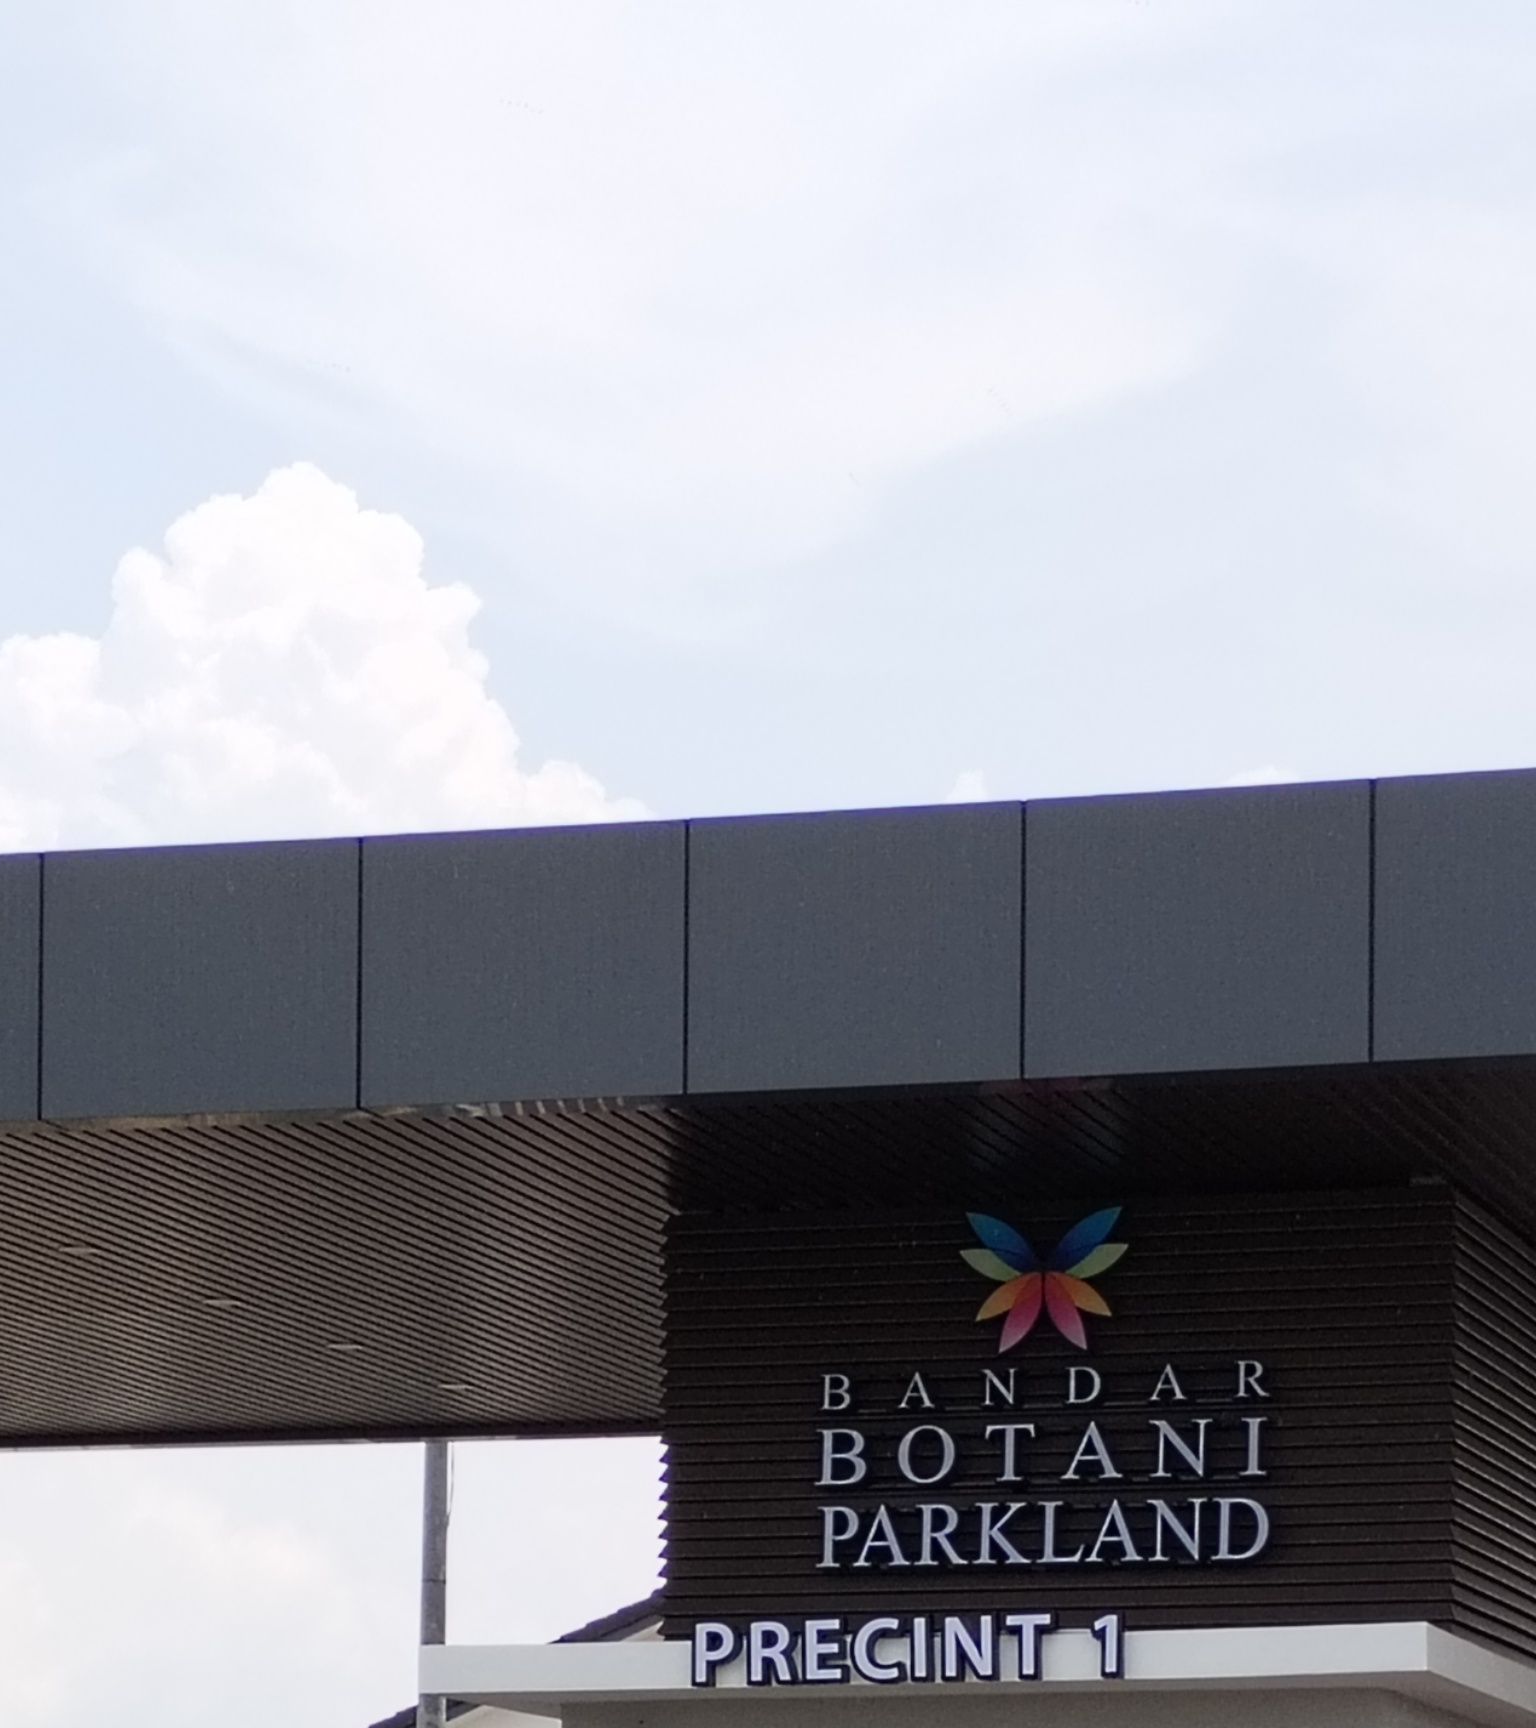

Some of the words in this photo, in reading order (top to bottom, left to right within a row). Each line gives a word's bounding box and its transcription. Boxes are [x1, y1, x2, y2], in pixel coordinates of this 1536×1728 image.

[821, 1360, 1270, 1412] BANDAR
[815, 1416, 1268, 1487] BOTANI
[815, 1497, 1270, 1569] PARKLAND
[690, 1612, 1052, 1686] PRECINT
[1090, 1613, 1125, 1679] 1
